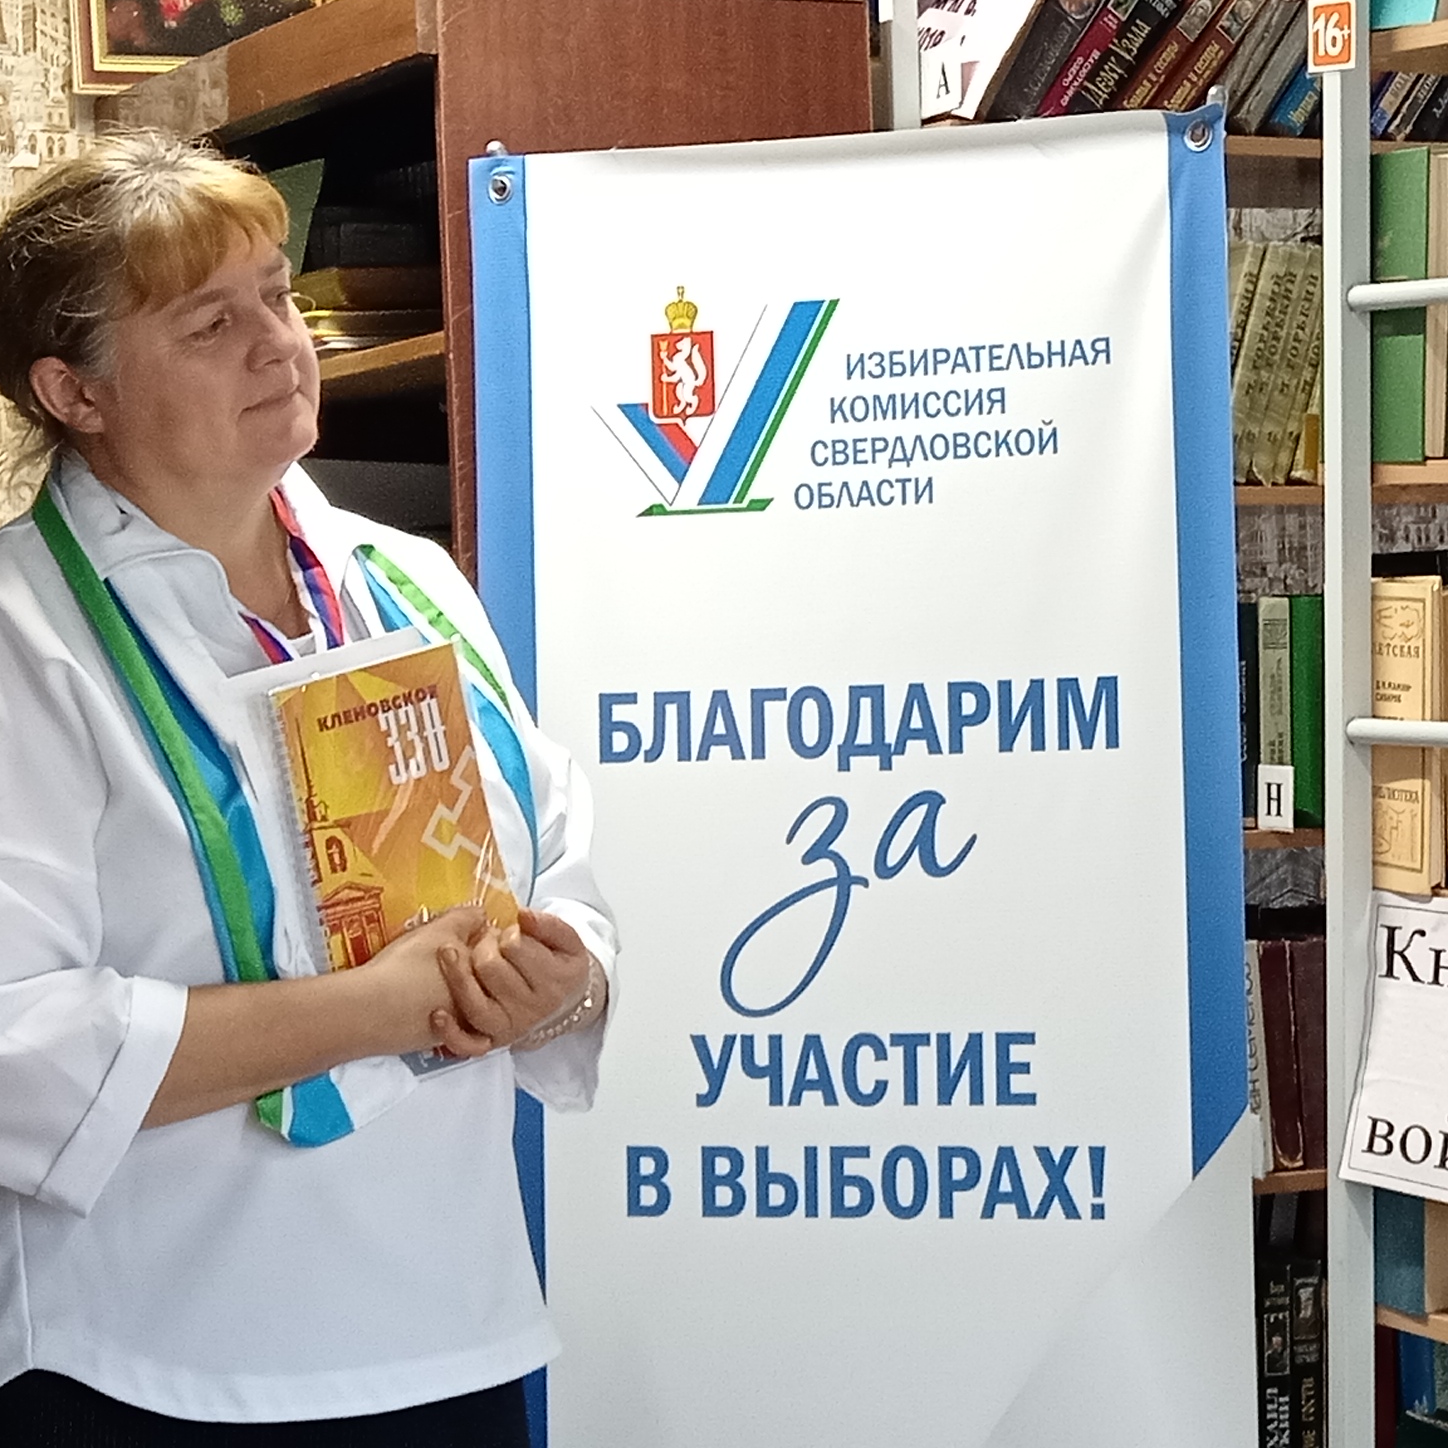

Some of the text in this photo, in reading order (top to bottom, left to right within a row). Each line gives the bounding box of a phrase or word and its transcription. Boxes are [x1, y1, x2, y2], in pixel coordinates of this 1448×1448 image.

[1313, 11, 1352, 58] 16+
[936, 61, 951, 100] А
[1252, 272, 1284, 370] ГОРЬКИЙ
[845, 335, 1112, 382] ИЗБИРАТЕЛЬНАЯ
[829, 386, 1007, 424] КОМИССИЯ
[809, 420, 1059, 468] СВЕРДЛОВСКОЙ
[793, 477, 935, 511] ОБЛАСТИ
[316, 684, 438, 734] КЛЕНОВСКОЕ
[597, 675, 1120, 772] БЛАГОДАРИМ
[1264, 782, 1284, 818] Н
[720, 789, 978, 1018] за
[689, 1031, 1037, 1108] УЧАСТИЕ
[626, 1144, 1106, 1220] В ВЫБОРАХ!
